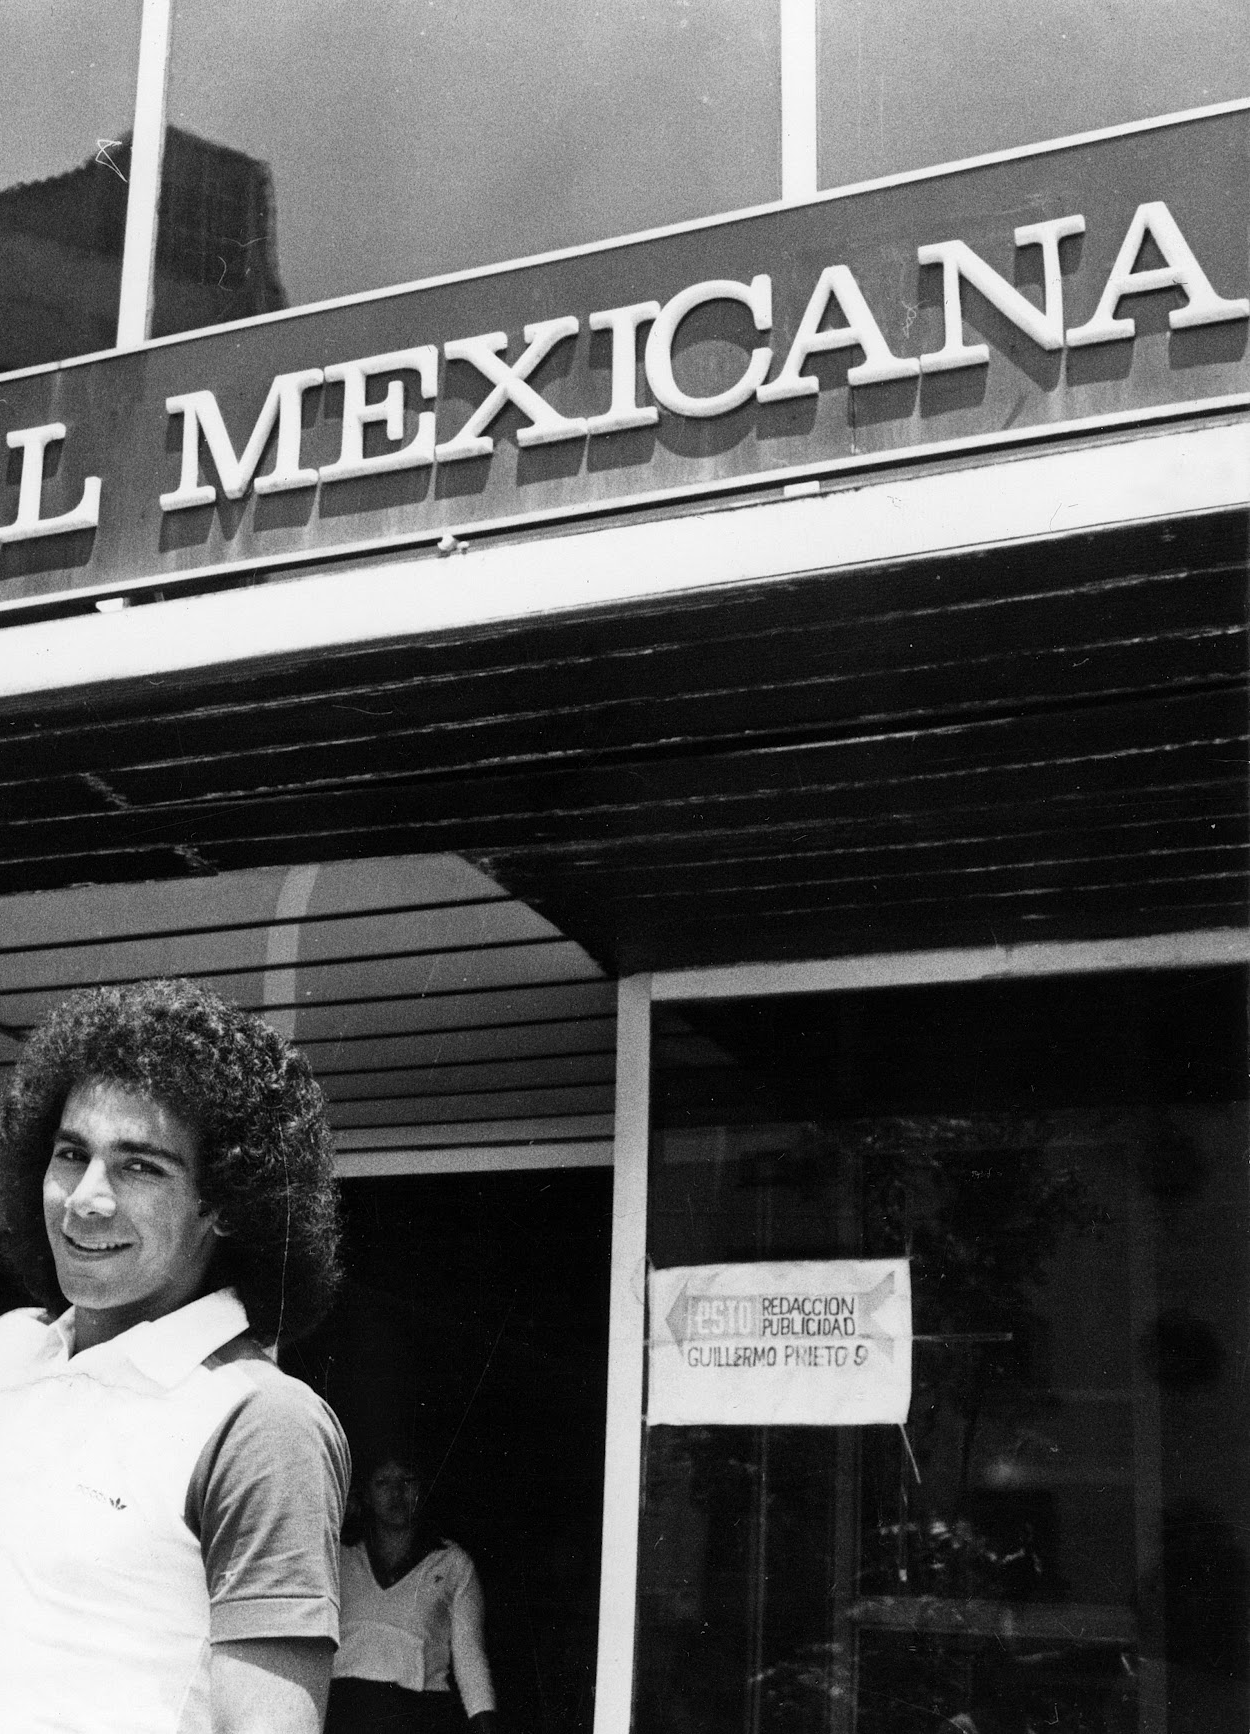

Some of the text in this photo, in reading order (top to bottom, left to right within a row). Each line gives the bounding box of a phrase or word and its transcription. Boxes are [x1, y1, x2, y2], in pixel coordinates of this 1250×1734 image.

[160, 201, 1250, 511] MEXICANA
[762, 1297, 855, 1316] REDACCION
[762, 1317, 856, 1336] PUBLICIDAD
[687, 1346, 777, 1367] GUILLERMO
